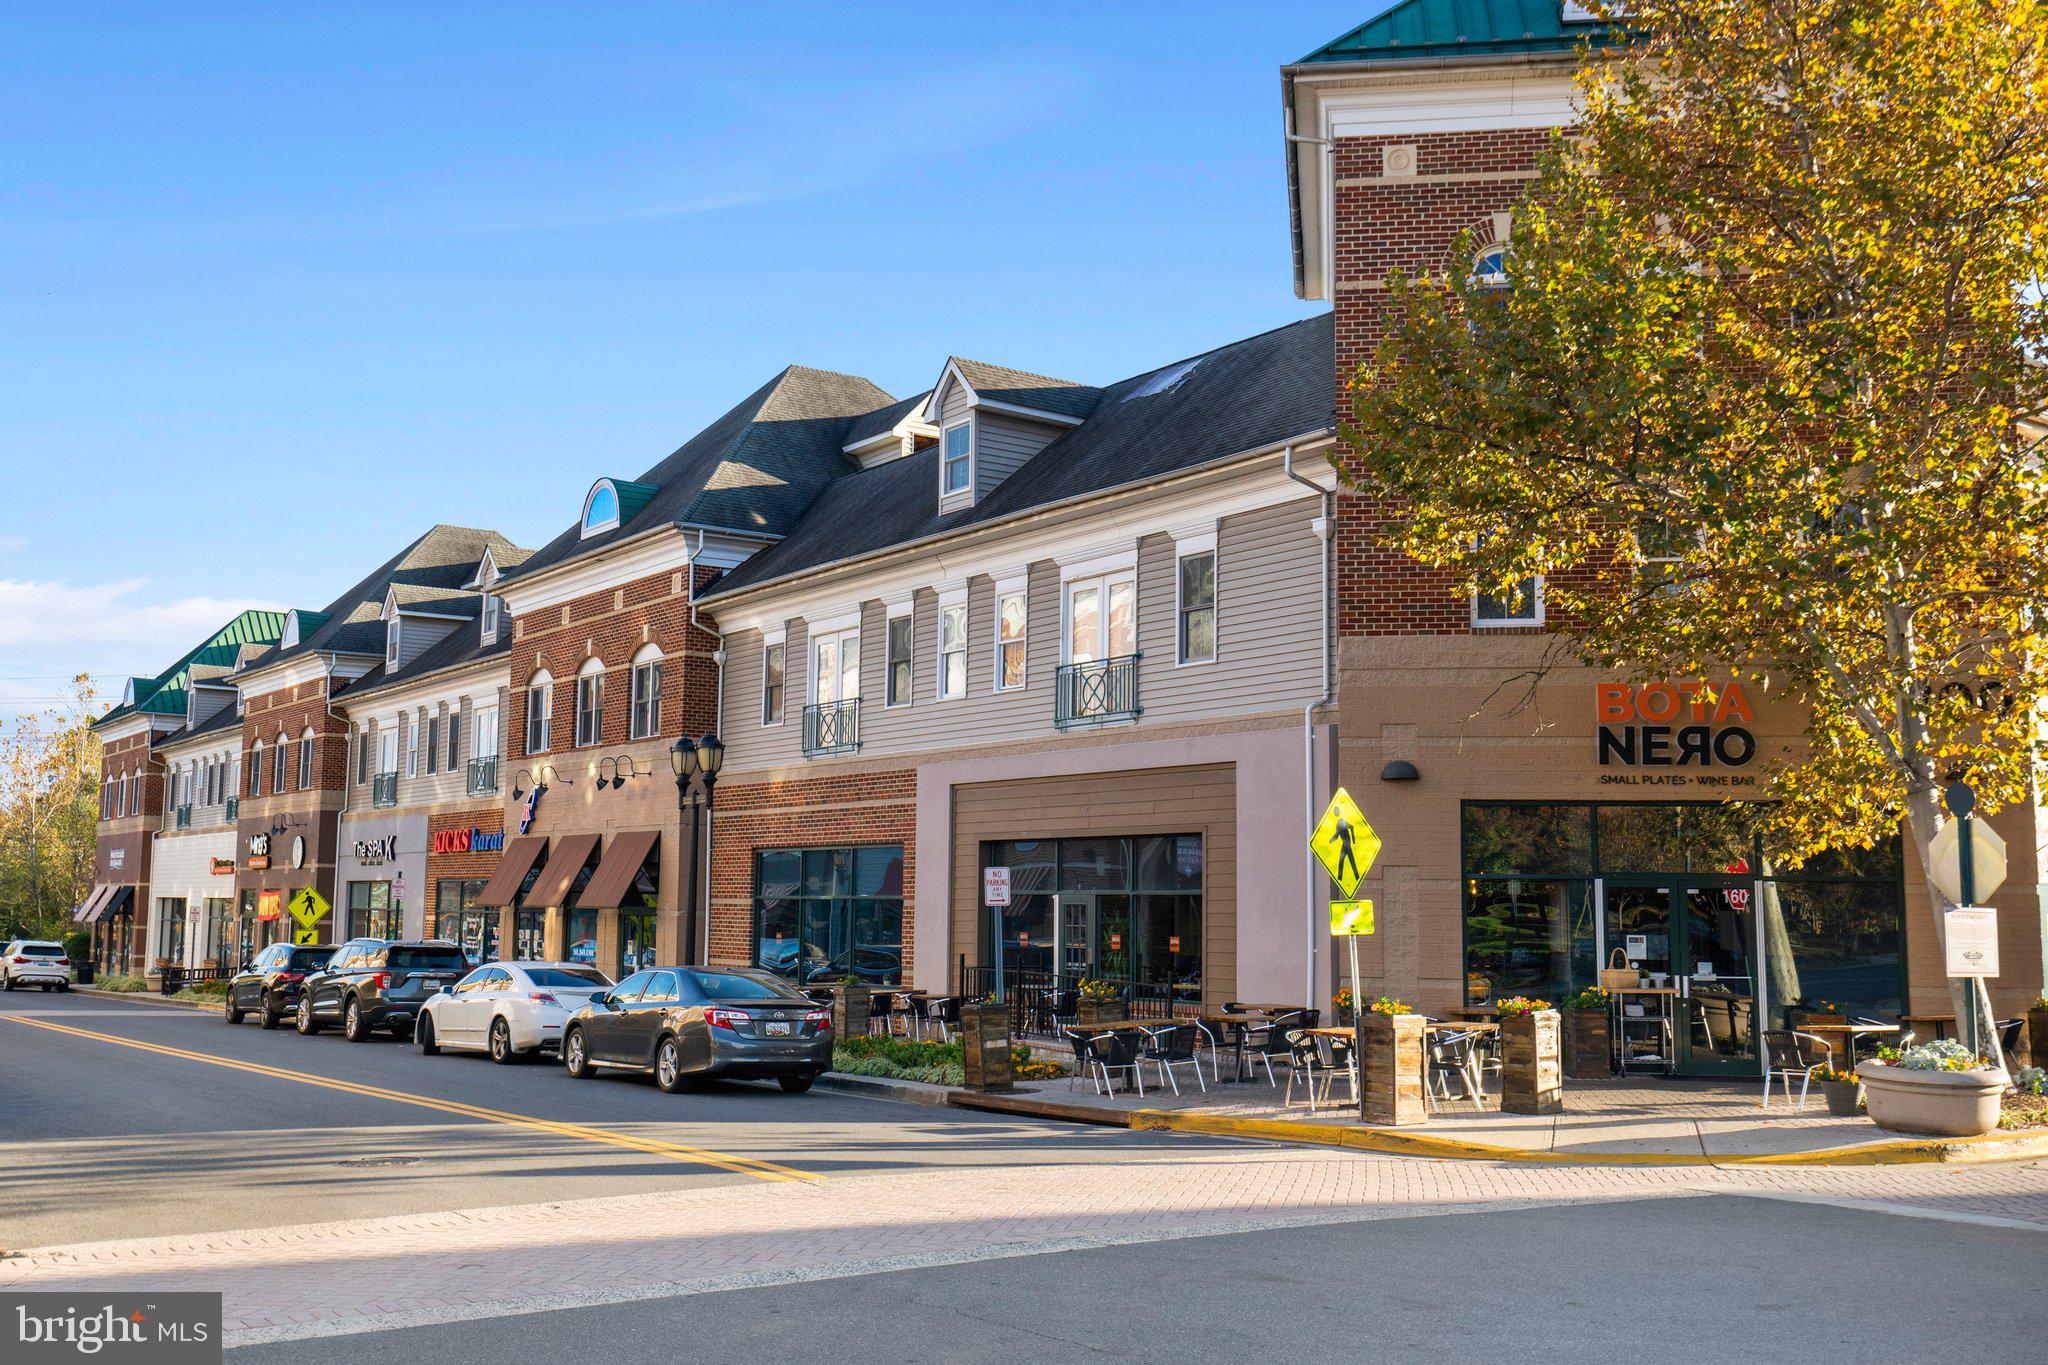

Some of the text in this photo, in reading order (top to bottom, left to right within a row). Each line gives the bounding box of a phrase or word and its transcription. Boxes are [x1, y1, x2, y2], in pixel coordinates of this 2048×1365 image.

[1596, 682, 1755, 723] BOTA
[1601, 775, 1756, 786] SMALL PLATES WINE BAR
[352, 835, 397, 861] The SPA K
[433, 827, 505, 853] KICKS karat
[992, 870, 1002, 878] NO
[986, 878, 1009, 887] PARKING
[1723, 888, 1748, 904] 160
